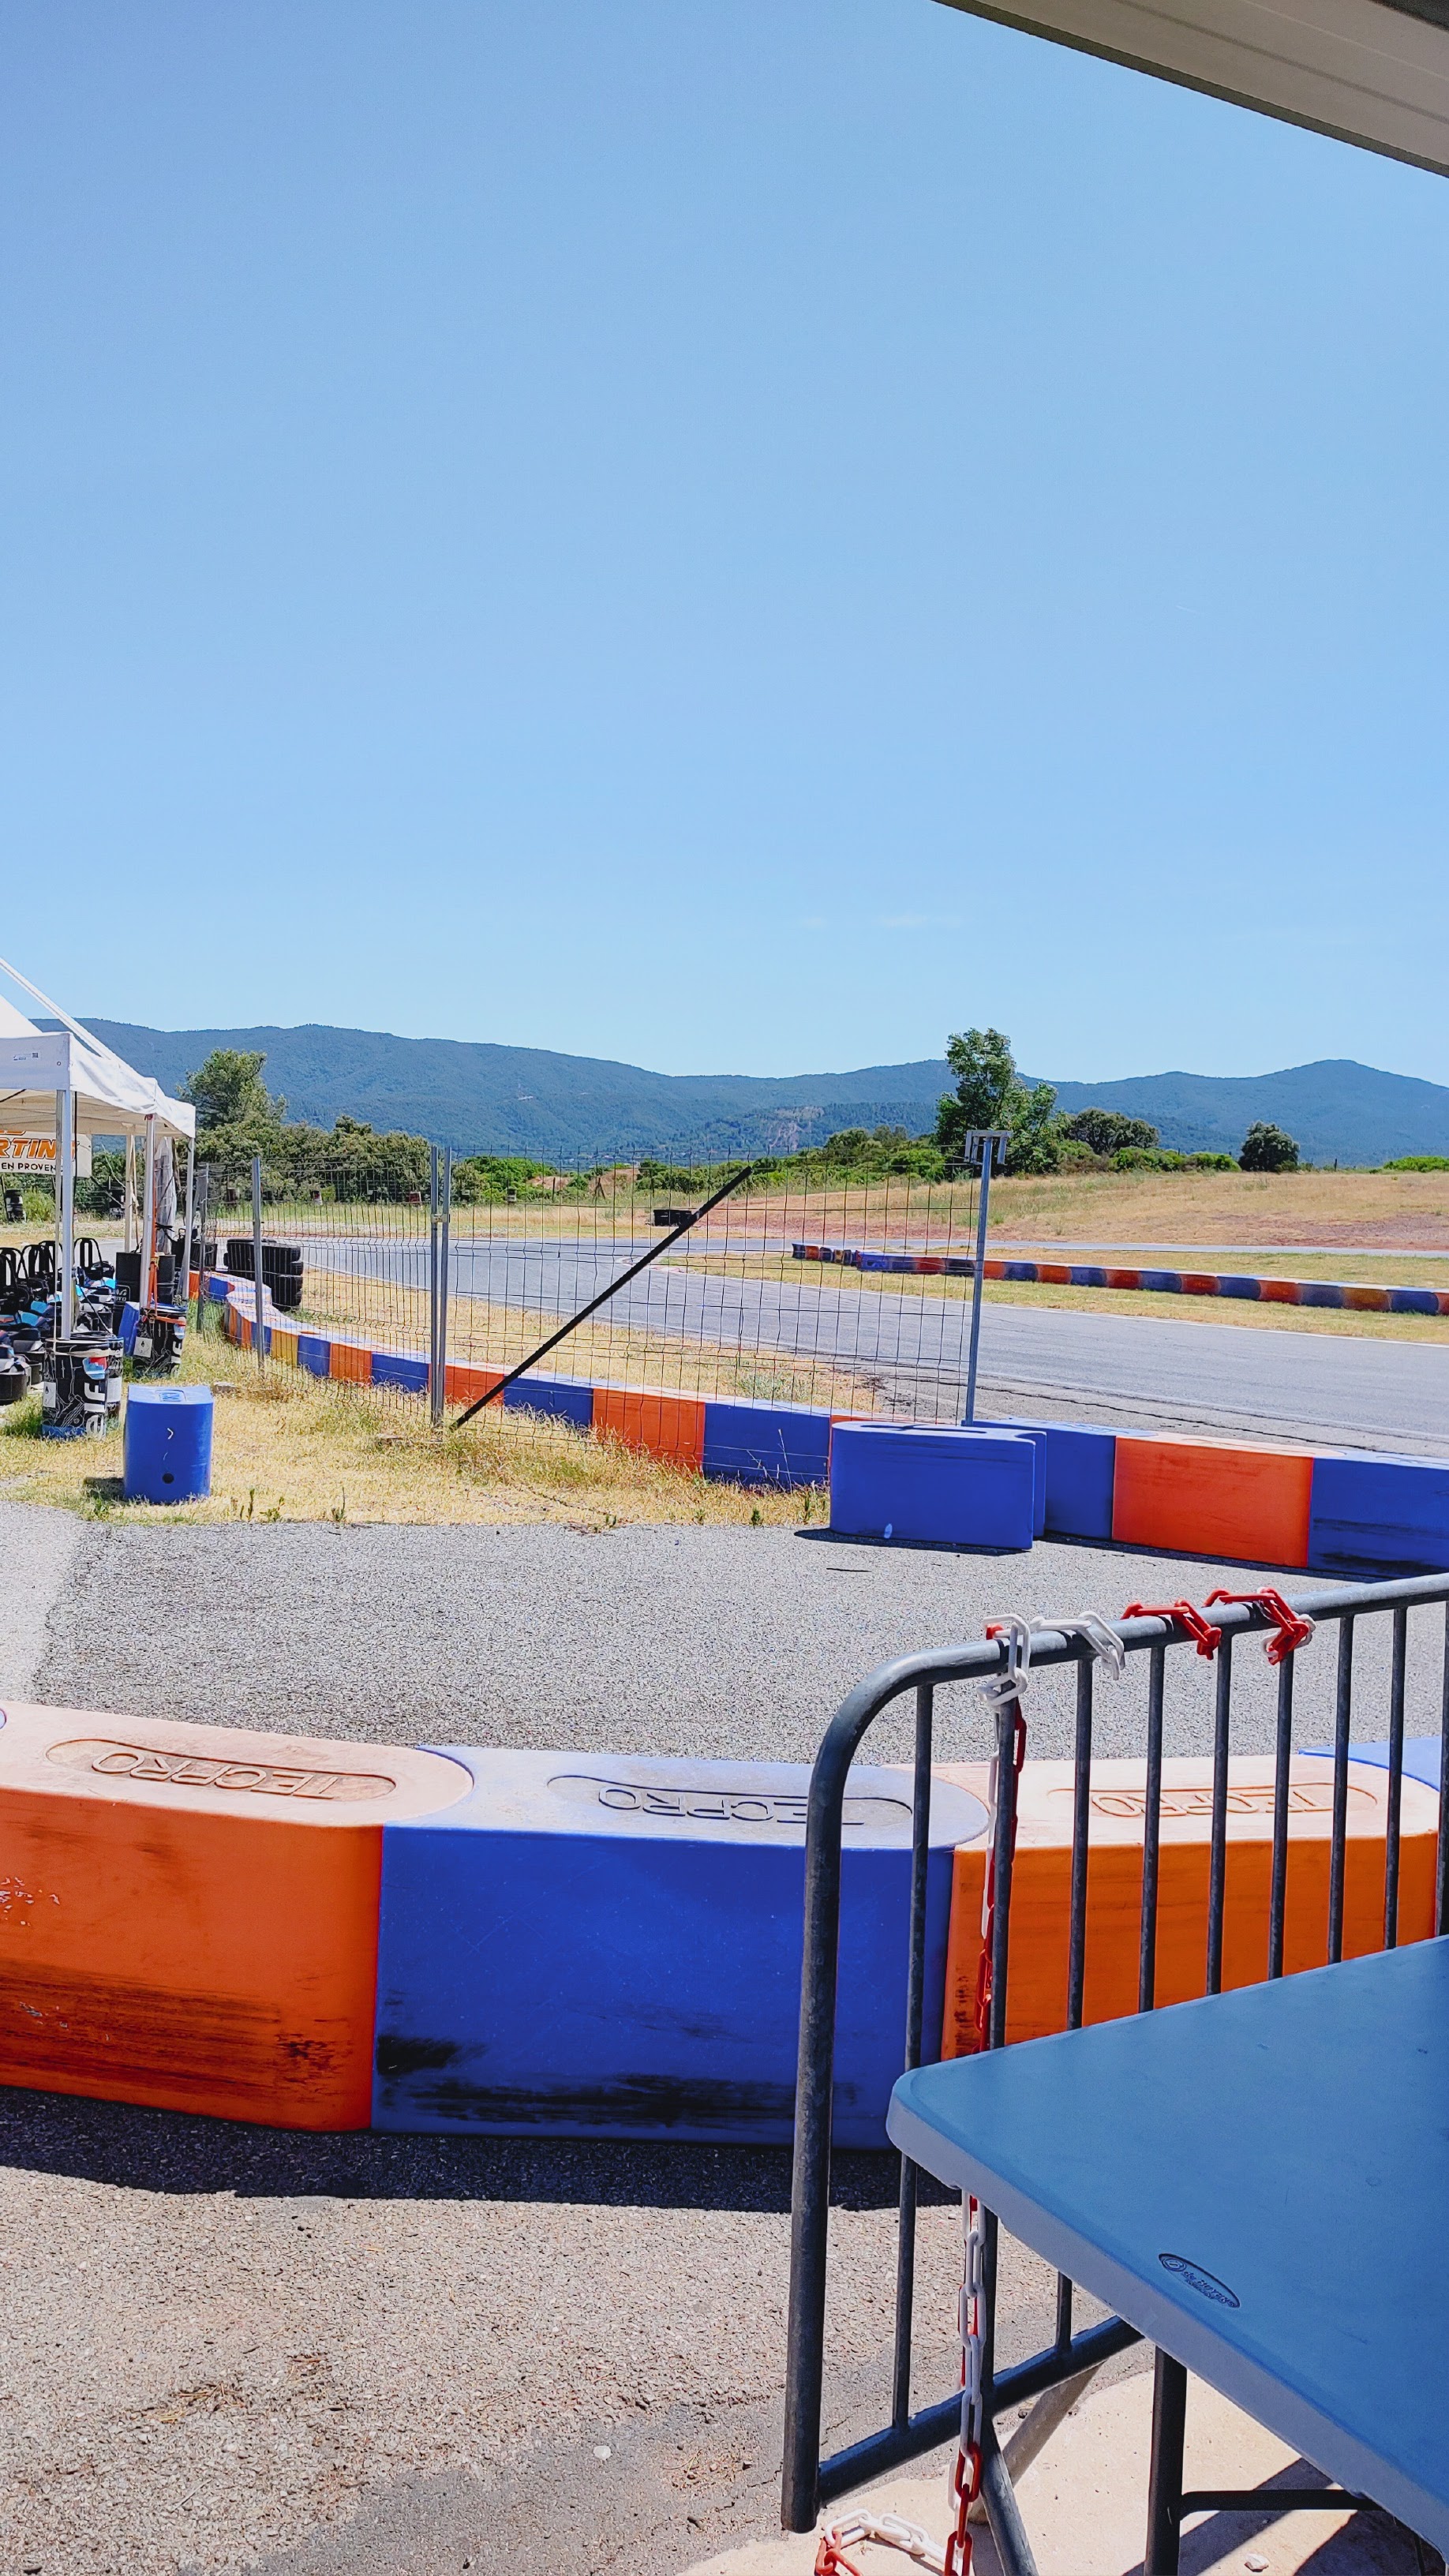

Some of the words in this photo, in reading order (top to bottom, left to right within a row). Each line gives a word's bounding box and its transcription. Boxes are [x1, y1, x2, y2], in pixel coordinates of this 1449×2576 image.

[0, 1137, 77, 1162] RTIN
[17, 1163, 63, 1173] PROVEN
[91, 1752, 339, 1800] TECPRO
